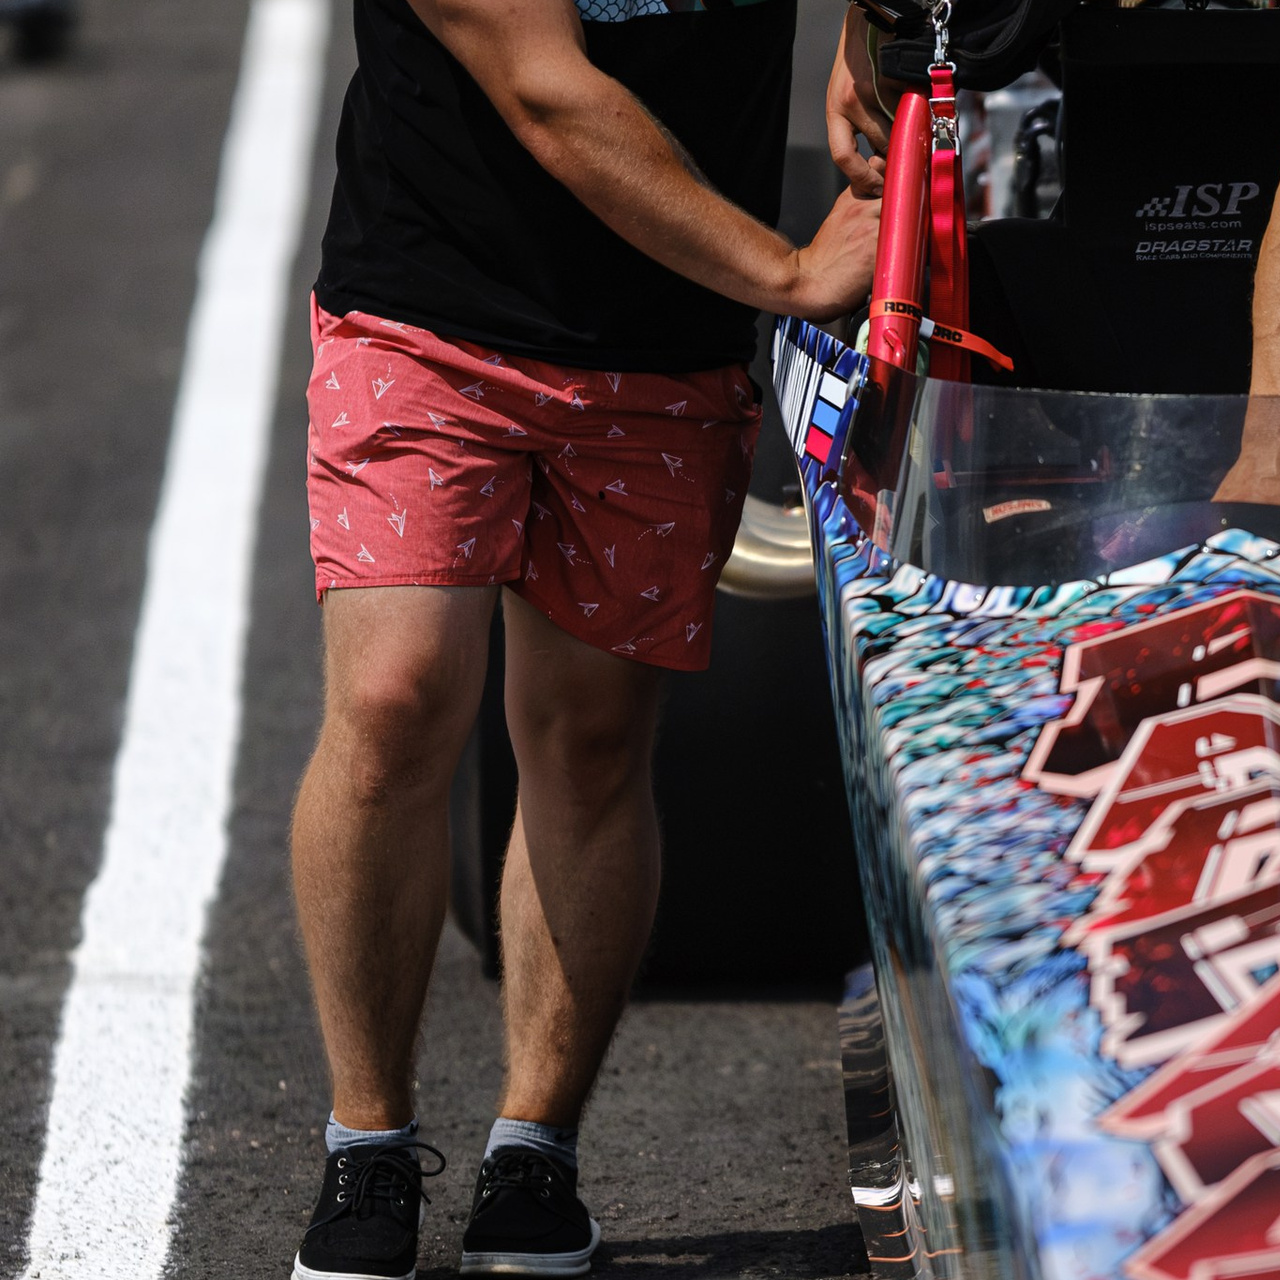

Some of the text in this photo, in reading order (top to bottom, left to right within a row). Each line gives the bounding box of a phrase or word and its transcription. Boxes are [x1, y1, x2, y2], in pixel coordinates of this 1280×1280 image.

[1168, 182, 1260, 217] ISP
[1145, 220, 1242, 232] ispseats.com
[1135, 240, 1253, 253] DRAGSTAR
